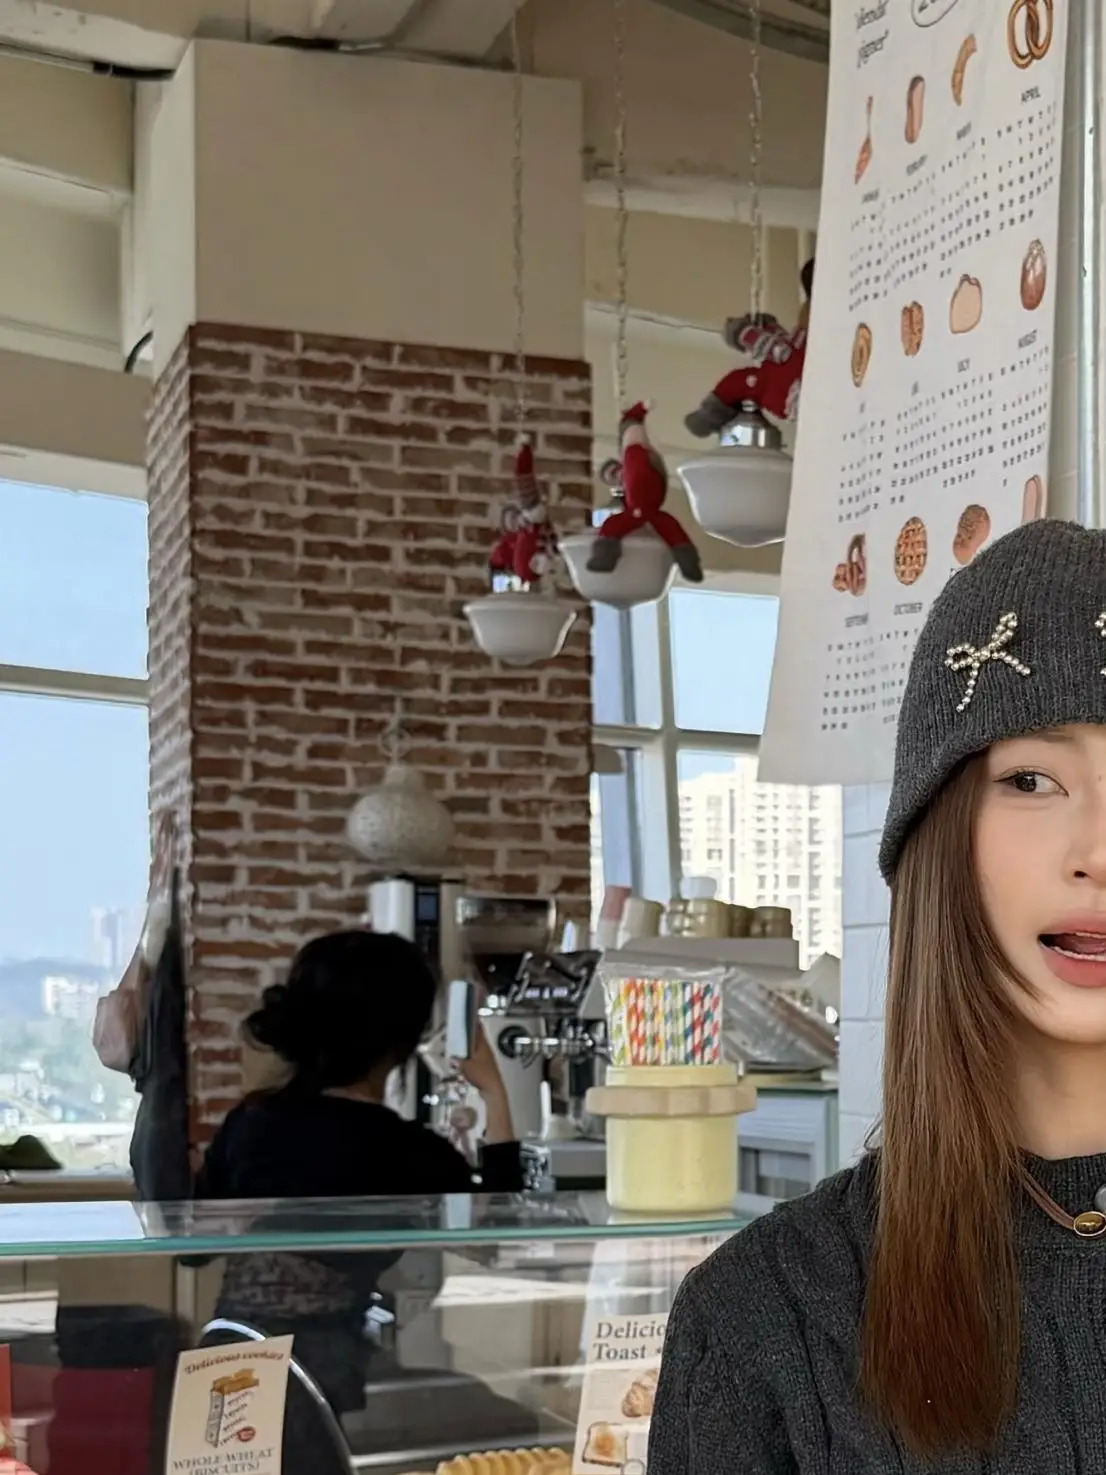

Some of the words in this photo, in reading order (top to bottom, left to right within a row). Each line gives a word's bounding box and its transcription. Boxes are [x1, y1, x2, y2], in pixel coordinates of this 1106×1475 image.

[593, 1342, 646, 1360] Toast
[173, 1454, 221, 1471] WHOLE
[225, 1448, 275, 1463] WHEAT
